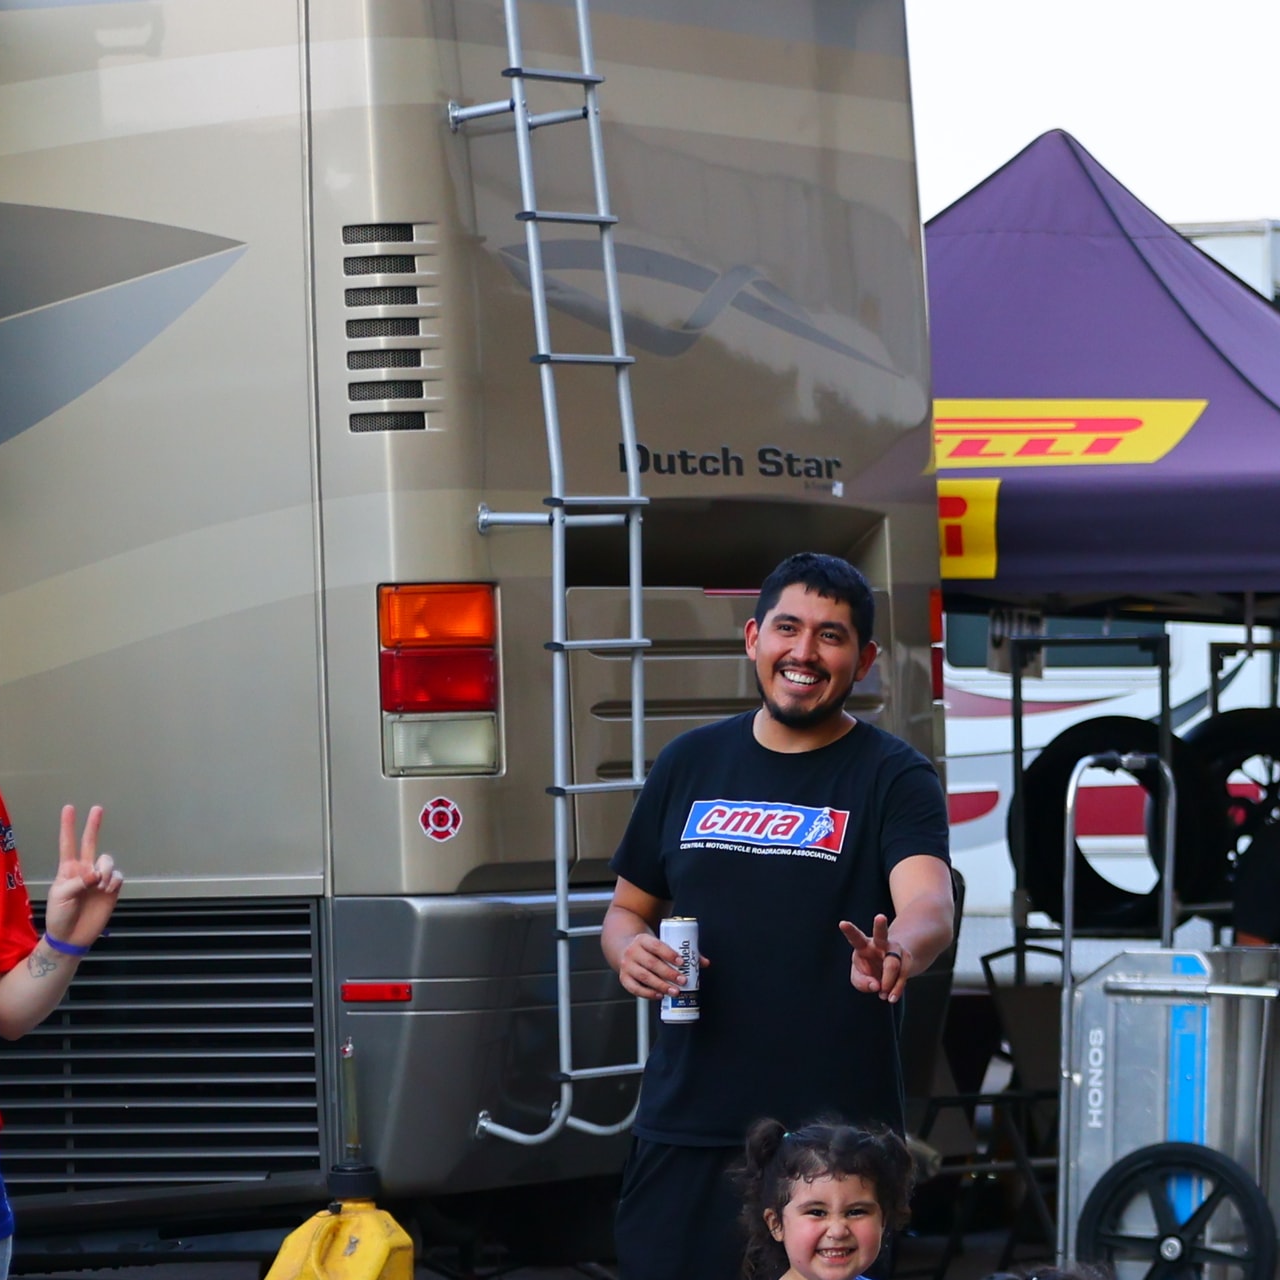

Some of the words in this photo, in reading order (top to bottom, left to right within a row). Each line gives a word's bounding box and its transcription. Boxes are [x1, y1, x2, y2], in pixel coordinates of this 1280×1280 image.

[618, 443, 744, 477] Dutch
[757, 447, 842, 479] Star
[697, 806, 804, 840] cmra
[680, 842, 705, 850] CENTRAL
[705, 842, 751, 853] MOTORCYCLE
[751, 847, 792, 856] ROADRACING
[791, 848, 837, 862] ASSOCIATION
[678, 940, 690, 977] Modelo
